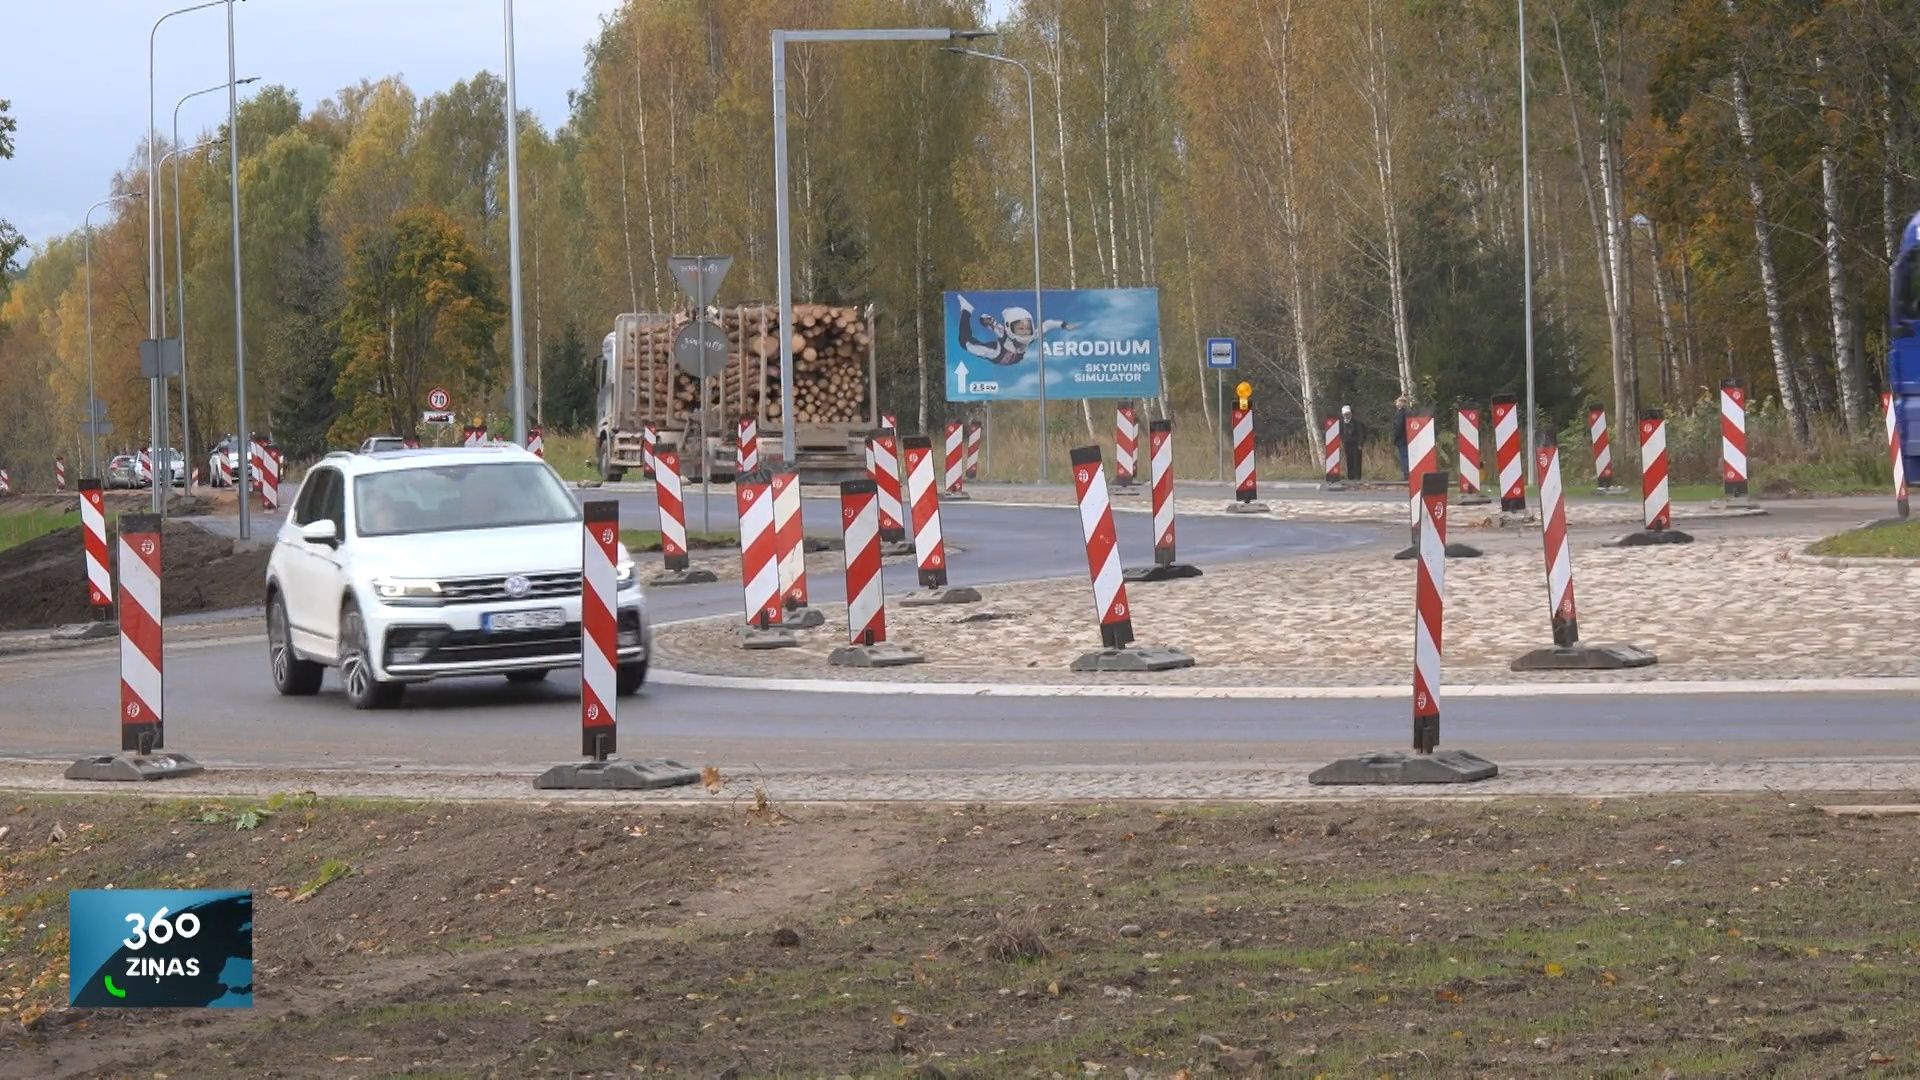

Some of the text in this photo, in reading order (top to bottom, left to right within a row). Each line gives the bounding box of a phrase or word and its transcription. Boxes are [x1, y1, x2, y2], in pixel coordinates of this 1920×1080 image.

[1042, 339, 1151, 357] AERODIUM
[1085, 362, 1151, 373] SKYDIVING
[1074, 373, 1142, 383] SIMULATOR
[434, 395, 445, 405] 70
